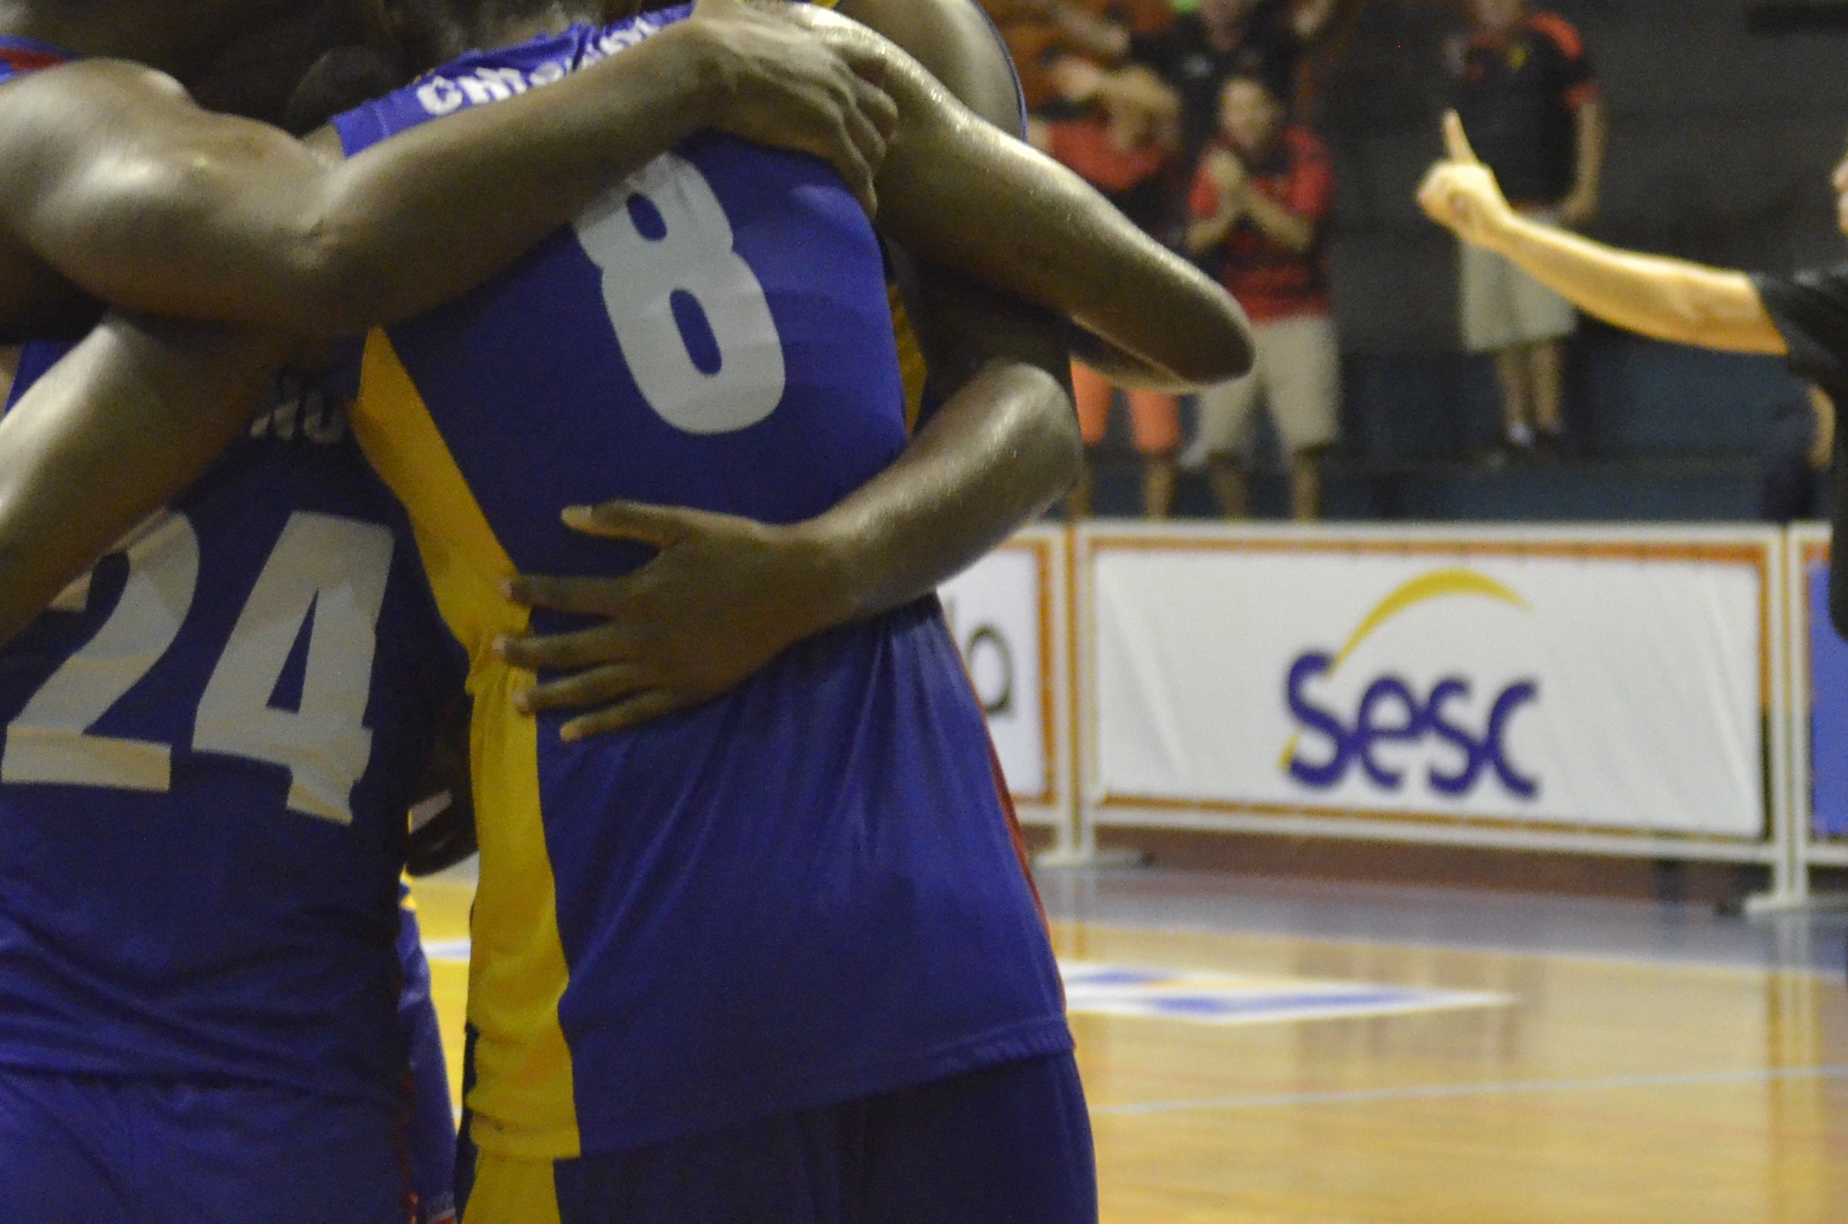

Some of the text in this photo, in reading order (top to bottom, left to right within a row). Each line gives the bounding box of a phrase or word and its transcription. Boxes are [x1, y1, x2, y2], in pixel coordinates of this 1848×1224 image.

[572, 150, 787, 436] 8
[0, 508, 396, 826] 24
[1282, 649, 1541, 800] Sesc
